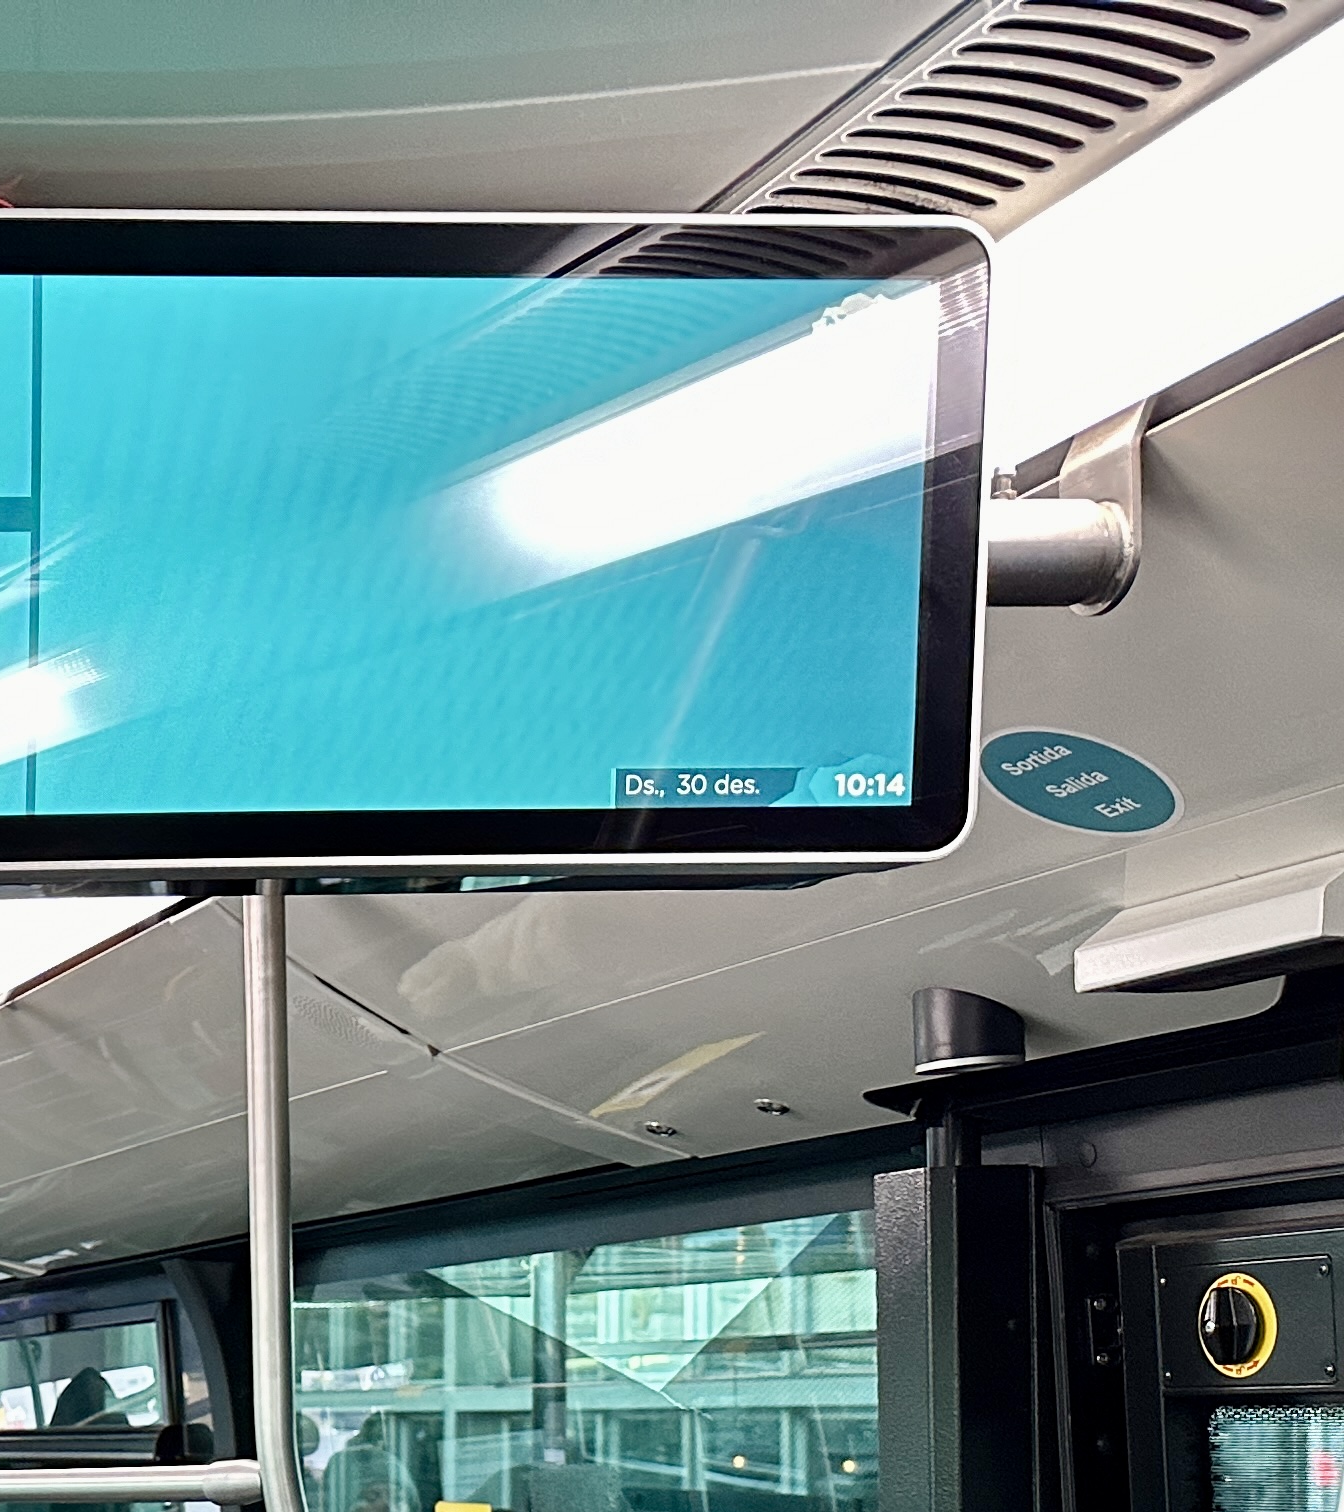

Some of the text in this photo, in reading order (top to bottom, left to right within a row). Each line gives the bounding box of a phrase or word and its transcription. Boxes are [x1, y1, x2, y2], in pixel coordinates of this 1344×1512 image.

[1001, 745, 1073, 776] Sortida
[676, 774, 707, 795] 30
[714, 773, 760, 796] des.
[835, 773, 906, 796] 10:14
[1045, 771, 1110, 798] Salida
[1094, 796, 1142, 818] Exit
